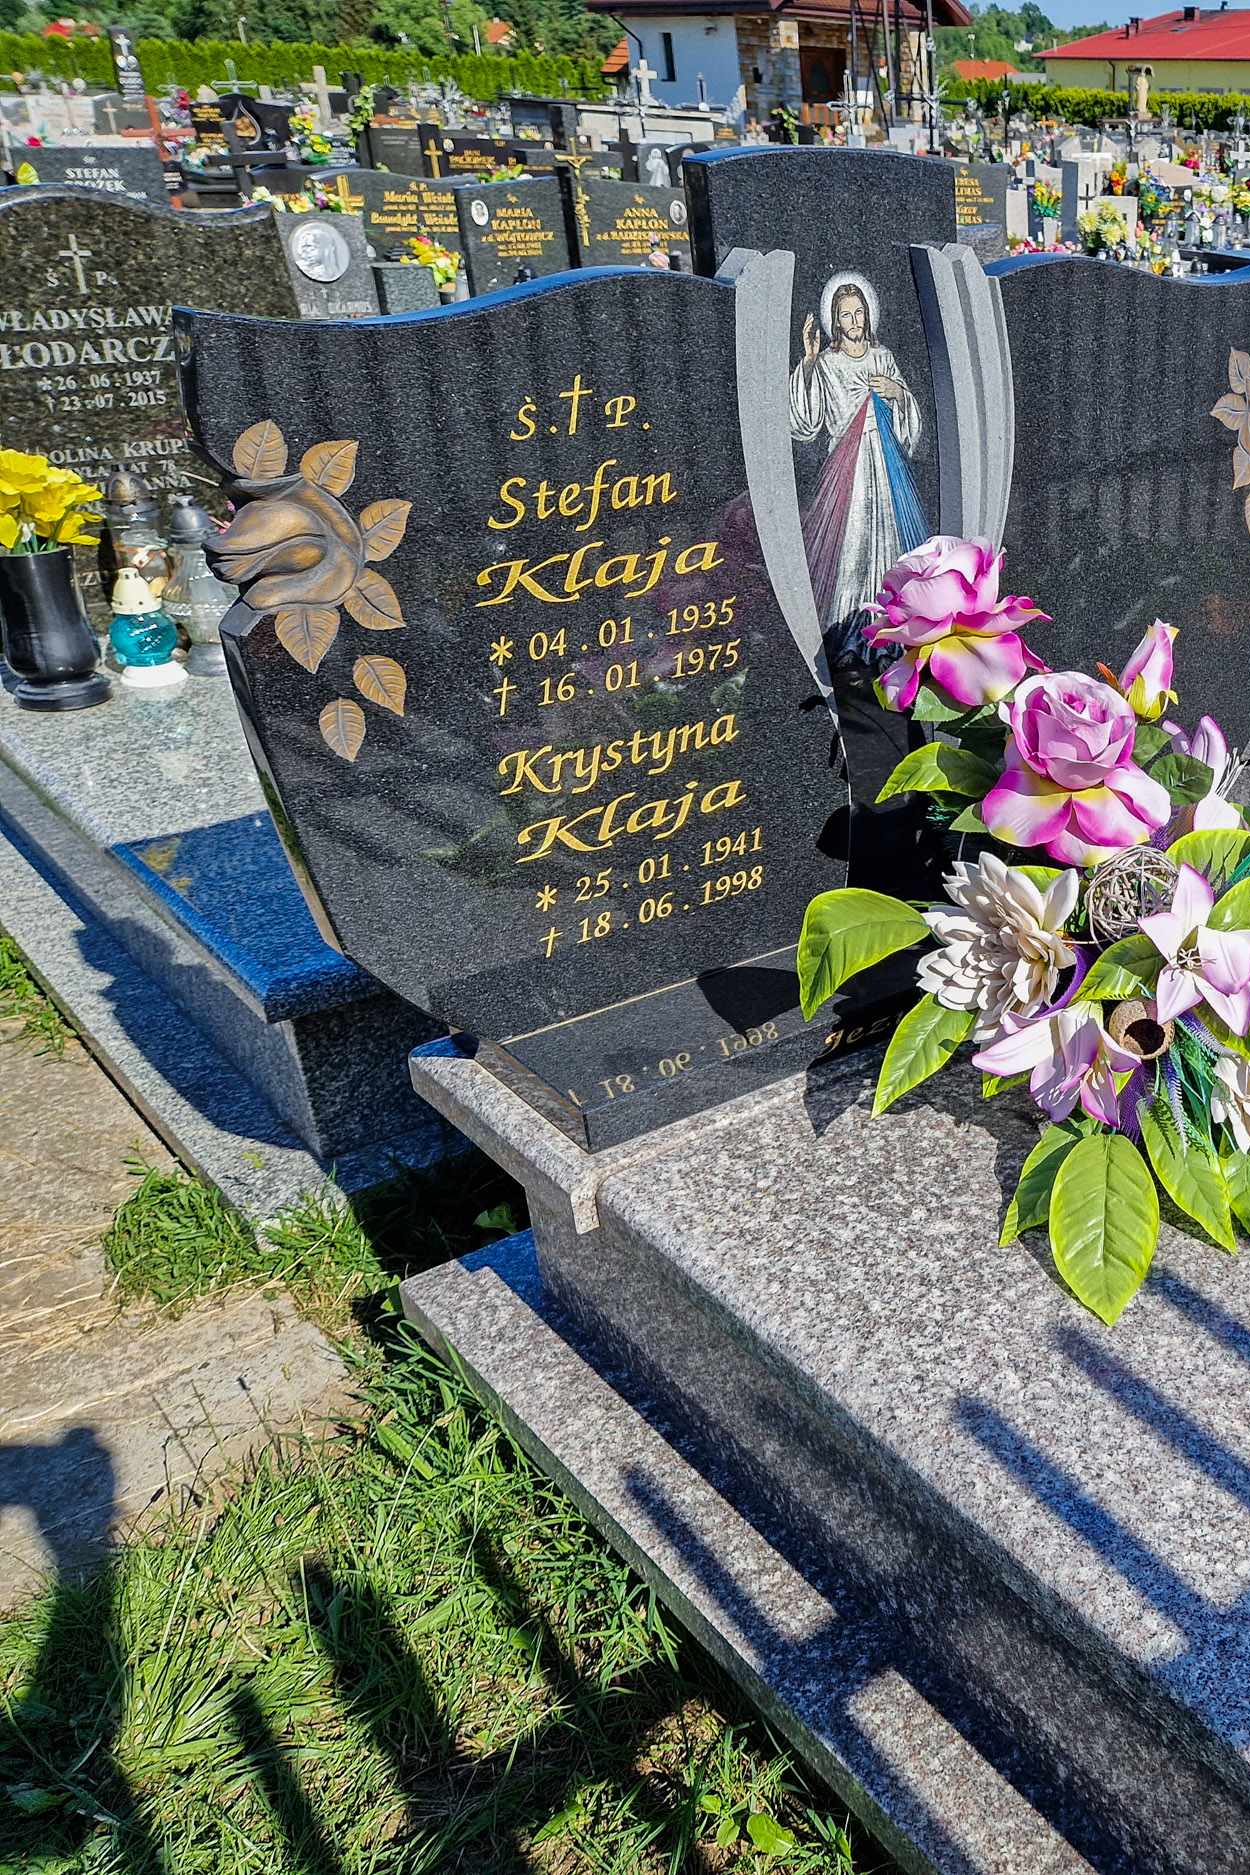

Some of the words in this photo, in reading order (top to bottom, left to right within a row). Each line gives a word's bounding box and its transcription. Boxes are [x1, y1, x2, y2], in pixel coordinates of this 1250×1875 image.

[64, 167, 121, 180] STEFAN
[623, 207, 659, 218] ANNA
[0, 335, 176, 369] ŁODARCZ
[486, 459, 678, 532] Stefan
[474, 536, 725, 608] Klaja
[528, 628, 567, 661] 04
[598, 616, 635, 648] 01
[665, 595, 738, 637] 1935
[537, 671, 576, 708] 16
[605, 661, 641, 693] 01
[671, 638, 743, 680] 1975
[497, 713, 741, 797] Krystyna
[514, 780, 748, 865] Klaja
[574, 867, 613, 904] 25
[637, 852, 673, 885] 01
[699, 827, 765, 867] 1941
[576, 910, 612, 945] 18
[638, 892, 674, 924] 06
[699, 865, 765, 906] 1998
[816, 1010, 905, 1060] Jez
